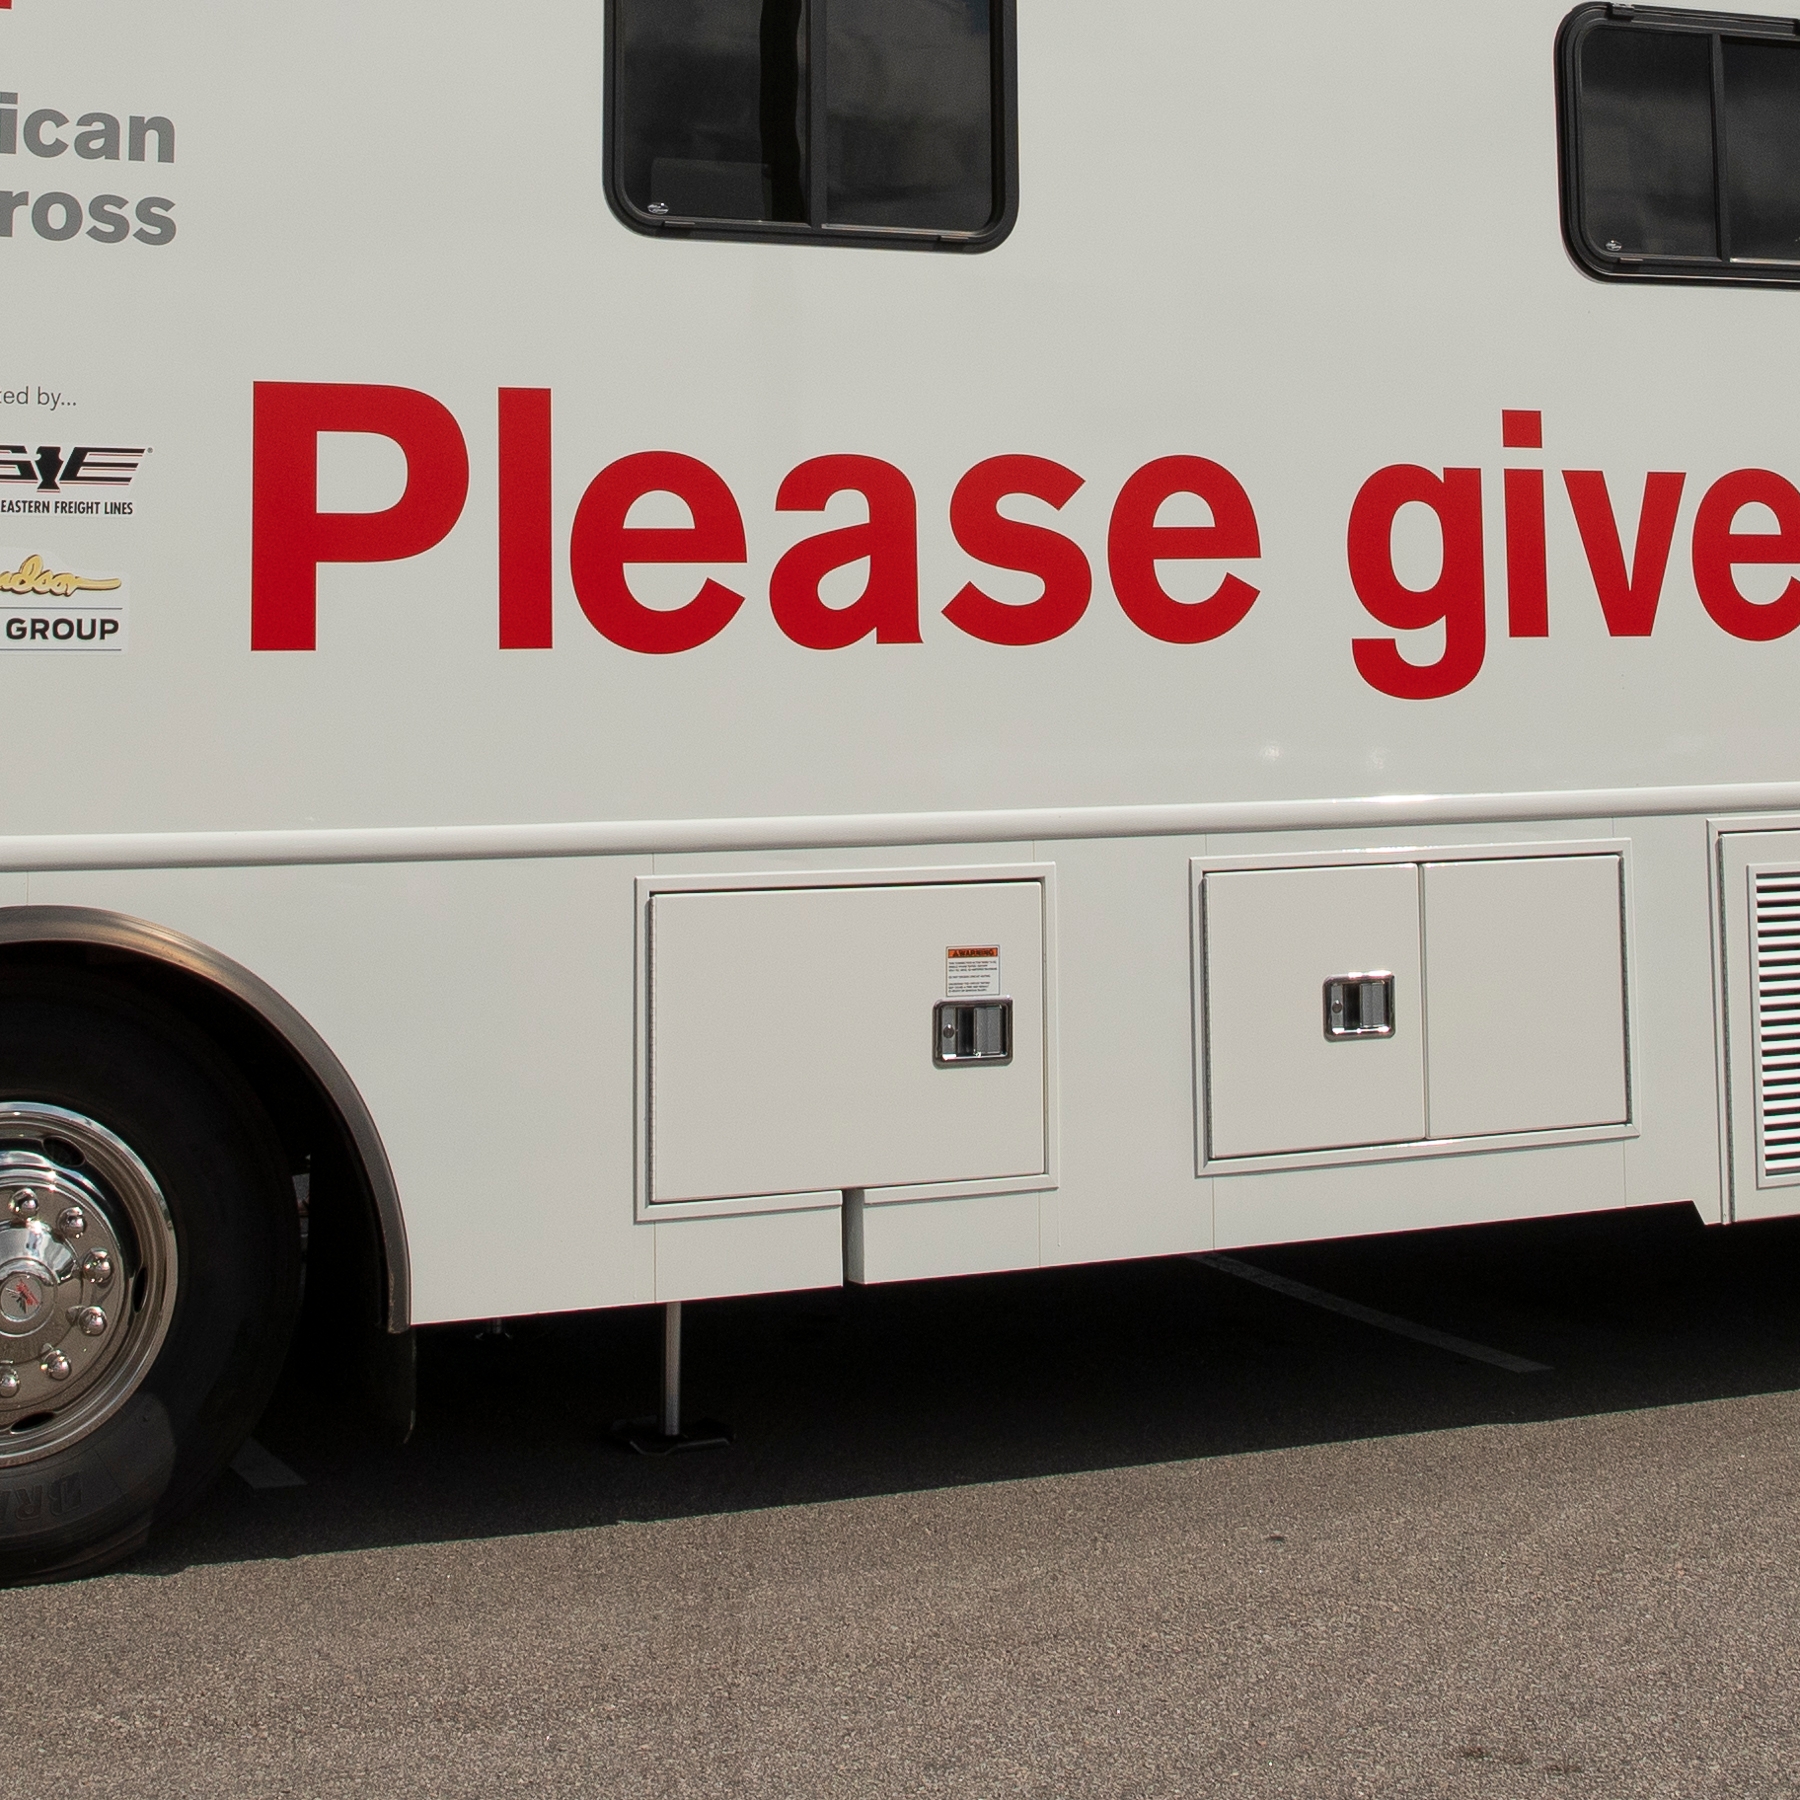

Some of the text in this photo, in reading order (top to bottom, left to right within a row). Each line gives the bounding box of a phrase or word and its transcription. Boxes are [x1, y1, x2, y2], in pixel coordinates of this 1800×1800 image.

[37, 386, 77, 412] by...
[54, 500, 101, 515] FREIGHT
[103, 501, 134, 516] LINES
[250, 381, 1261, 656] Please
[5, 617, 120, 642] GROUP
